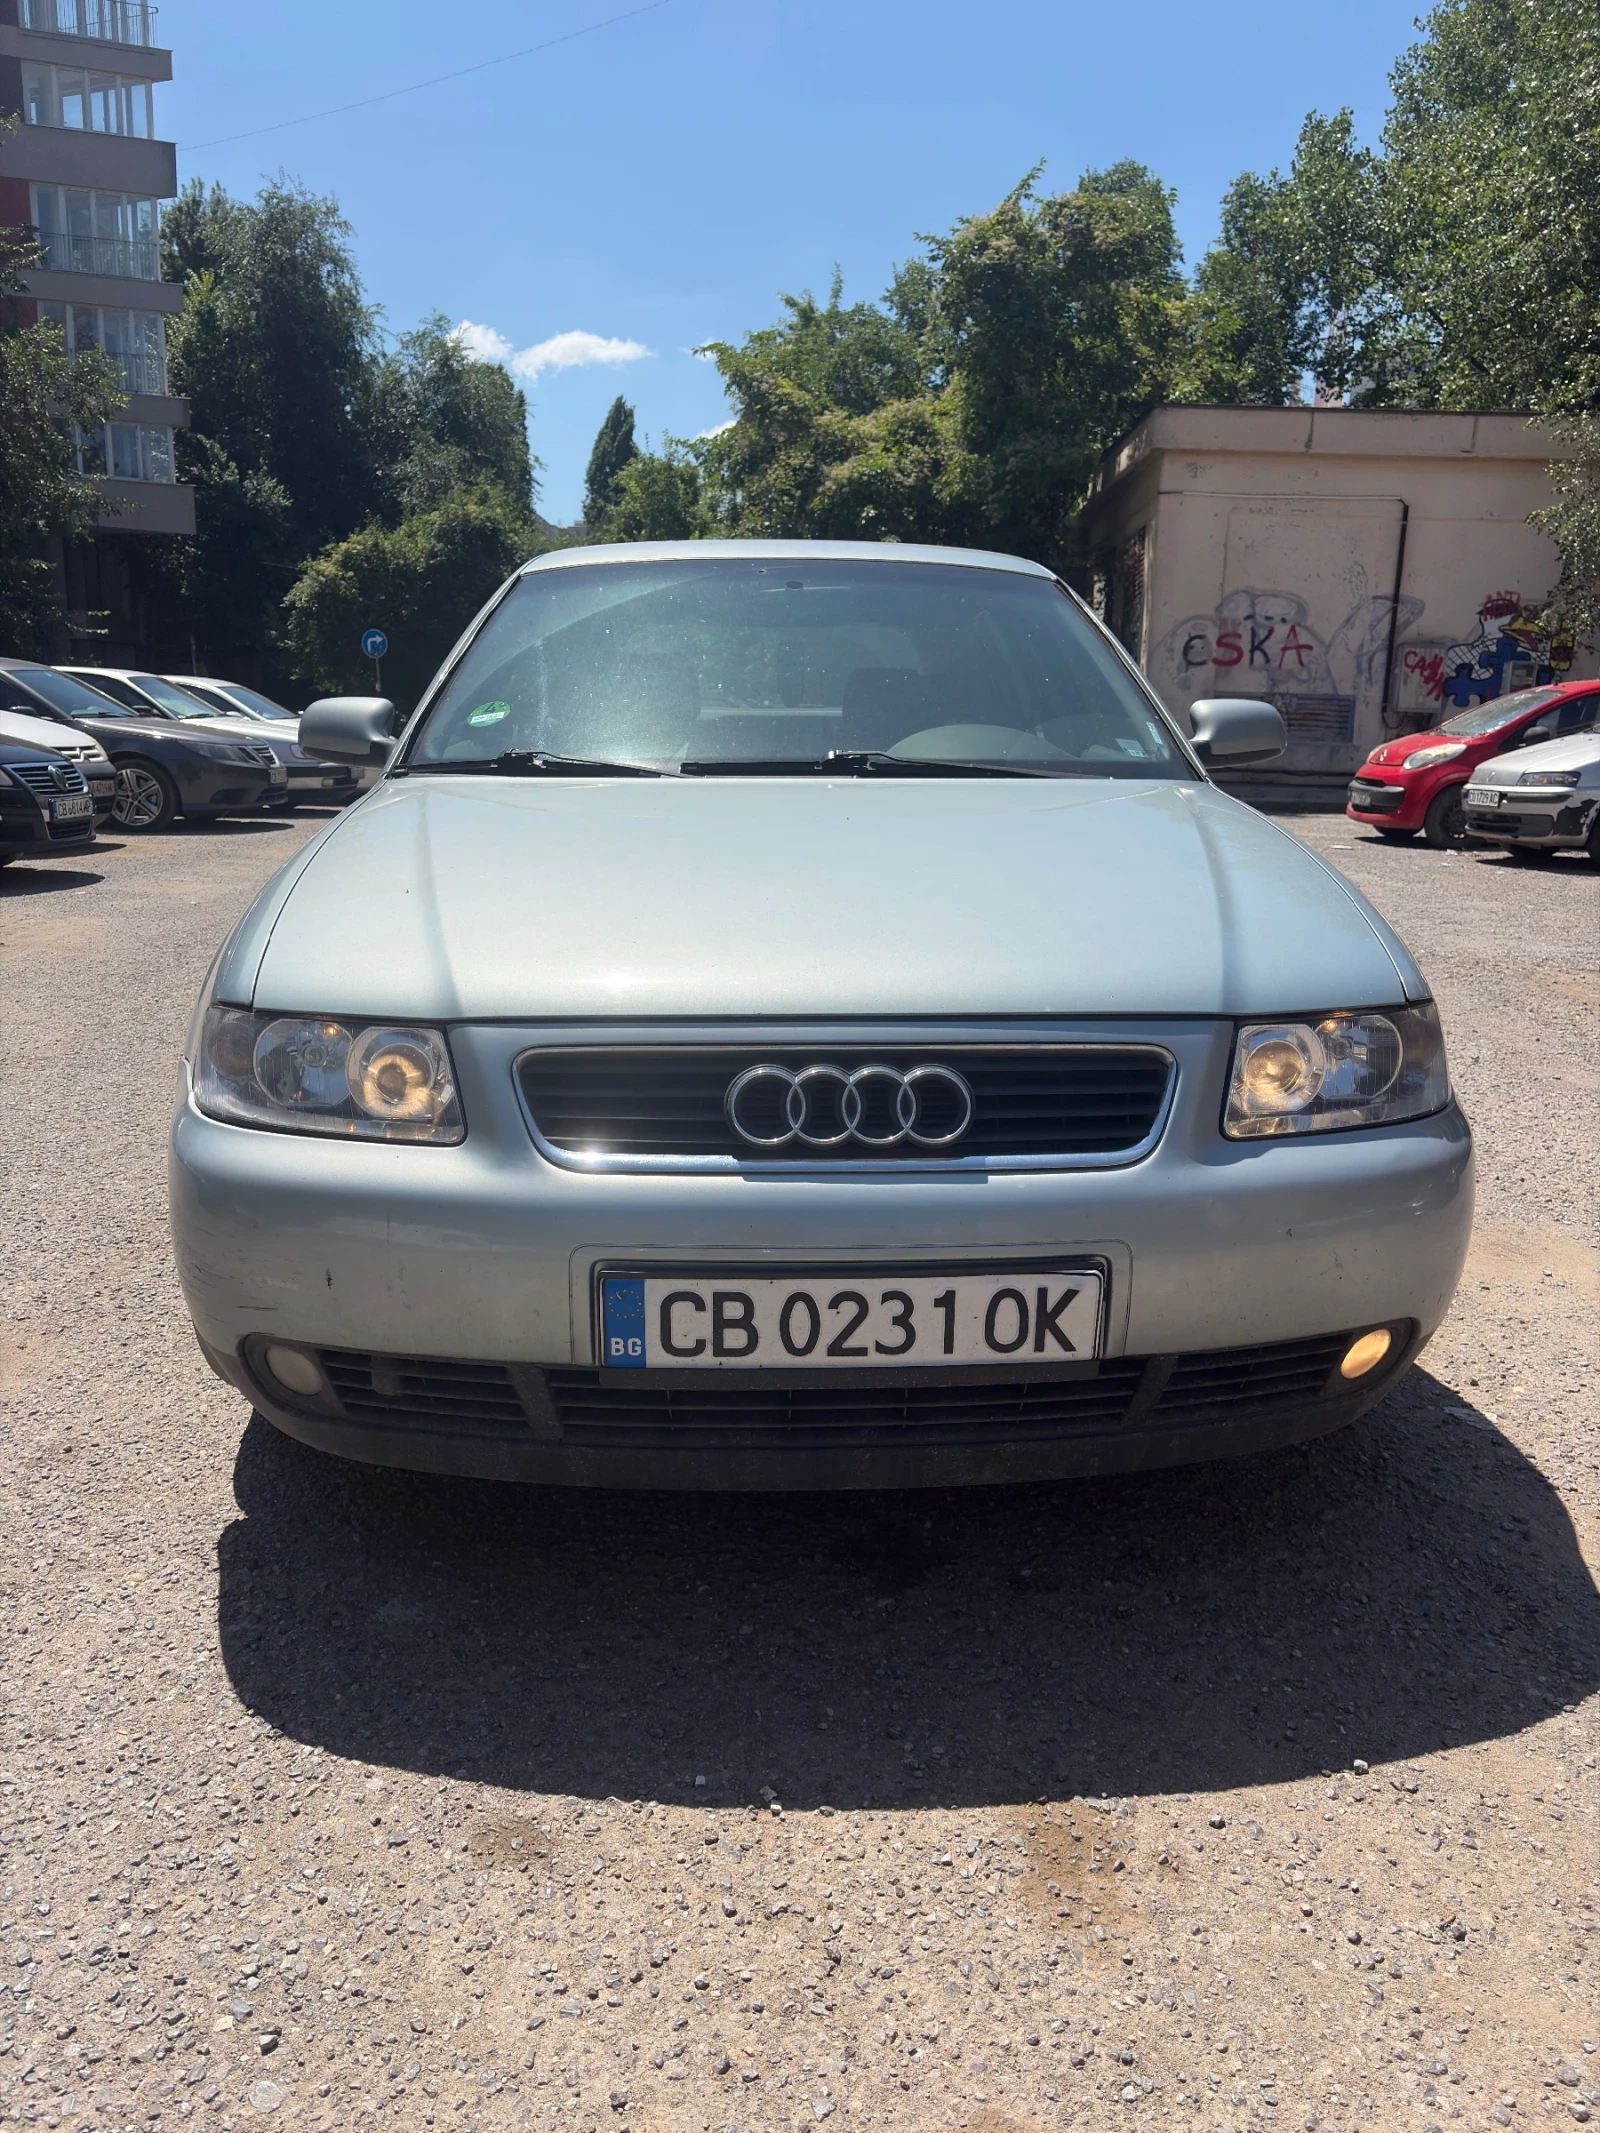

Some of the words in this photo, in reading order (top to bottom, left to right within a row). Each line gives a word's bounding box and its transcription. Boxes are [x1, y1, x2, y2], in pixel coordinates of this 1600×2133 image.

[1183, 624, 1314, 670] CSKA
[660, 1291, 759, 1357] CB
[779, 1289, 956, 1357] 0231
[984, 1287, 1080, 1354] OK
[610, 1338, 642, 1356] BG
